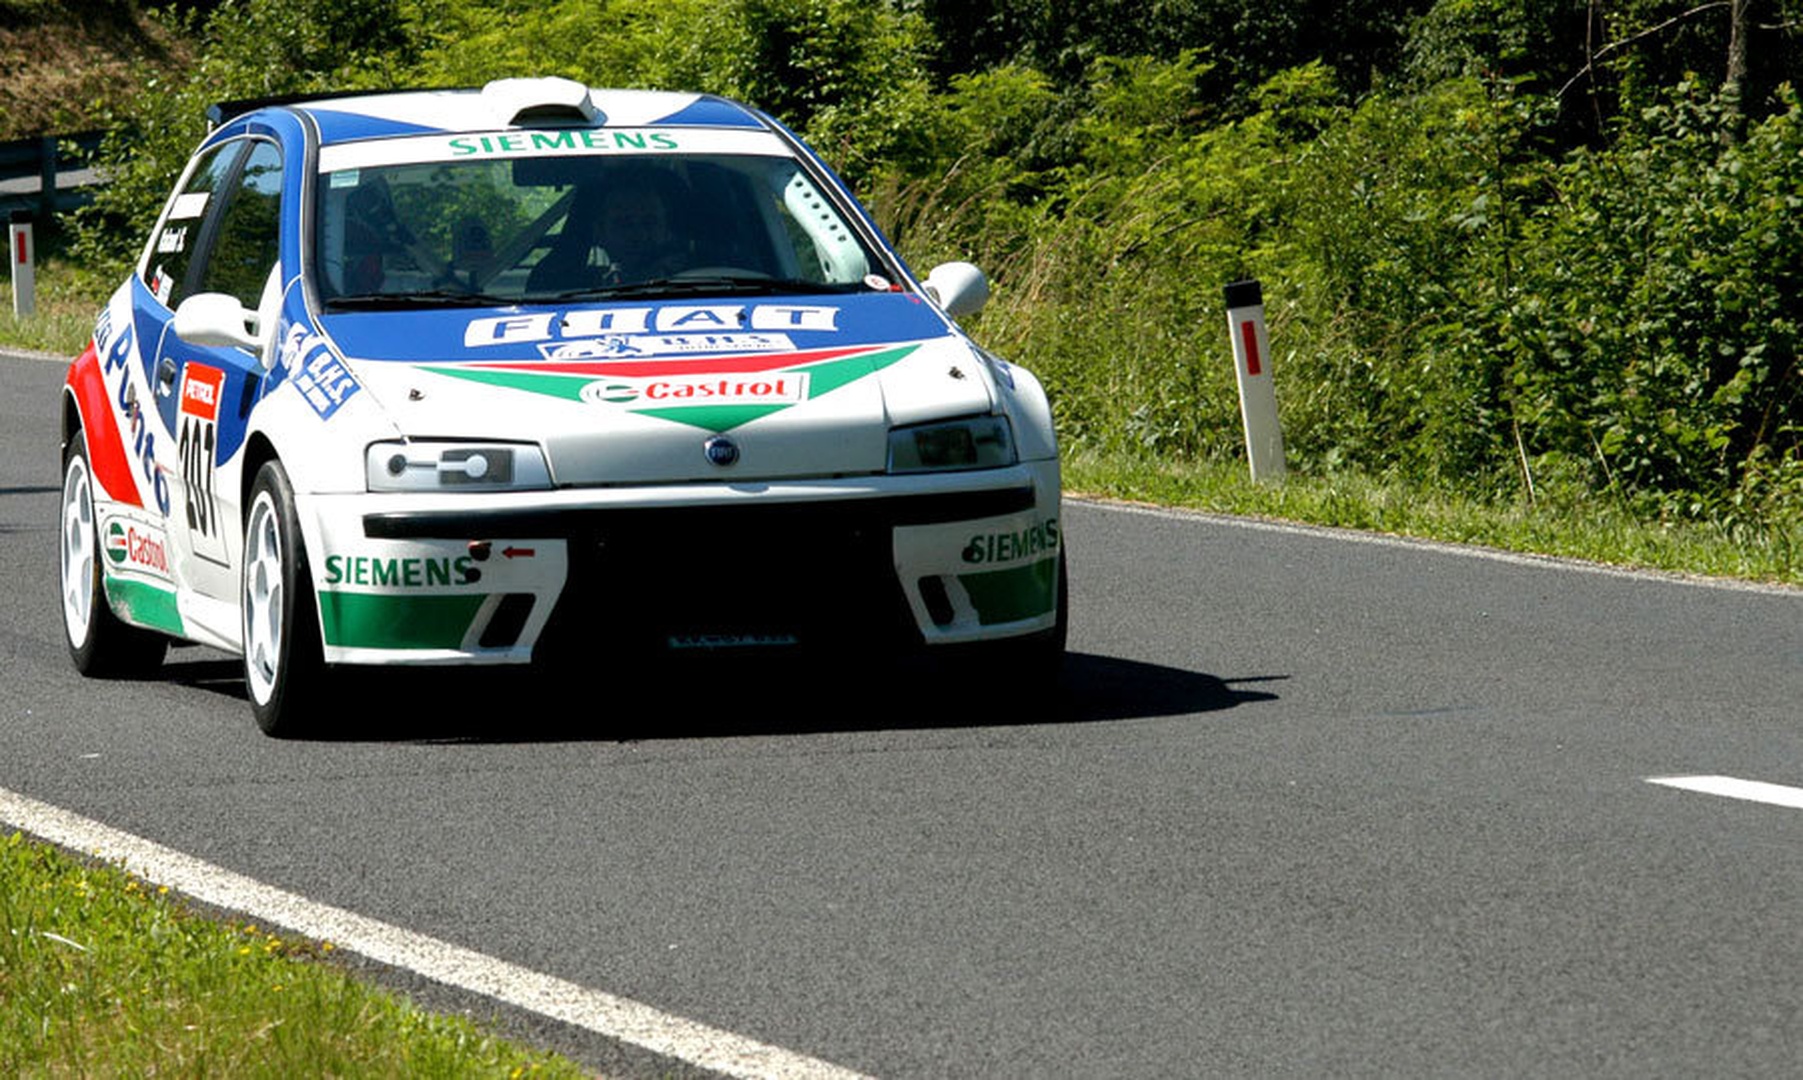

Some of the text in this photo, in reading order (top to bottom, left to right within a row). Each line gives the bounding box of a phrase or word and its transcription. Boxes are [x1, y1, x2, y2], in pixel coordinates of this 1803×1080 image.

[449, 131, 679, 155] SIEMENS
[483, 307, 826, 343] FIAT
[645, 378, 788, 400] Castrol
[967, 518, 1058, 564] SIEMENS
[325, 554, 474, 587] SIEMENS
